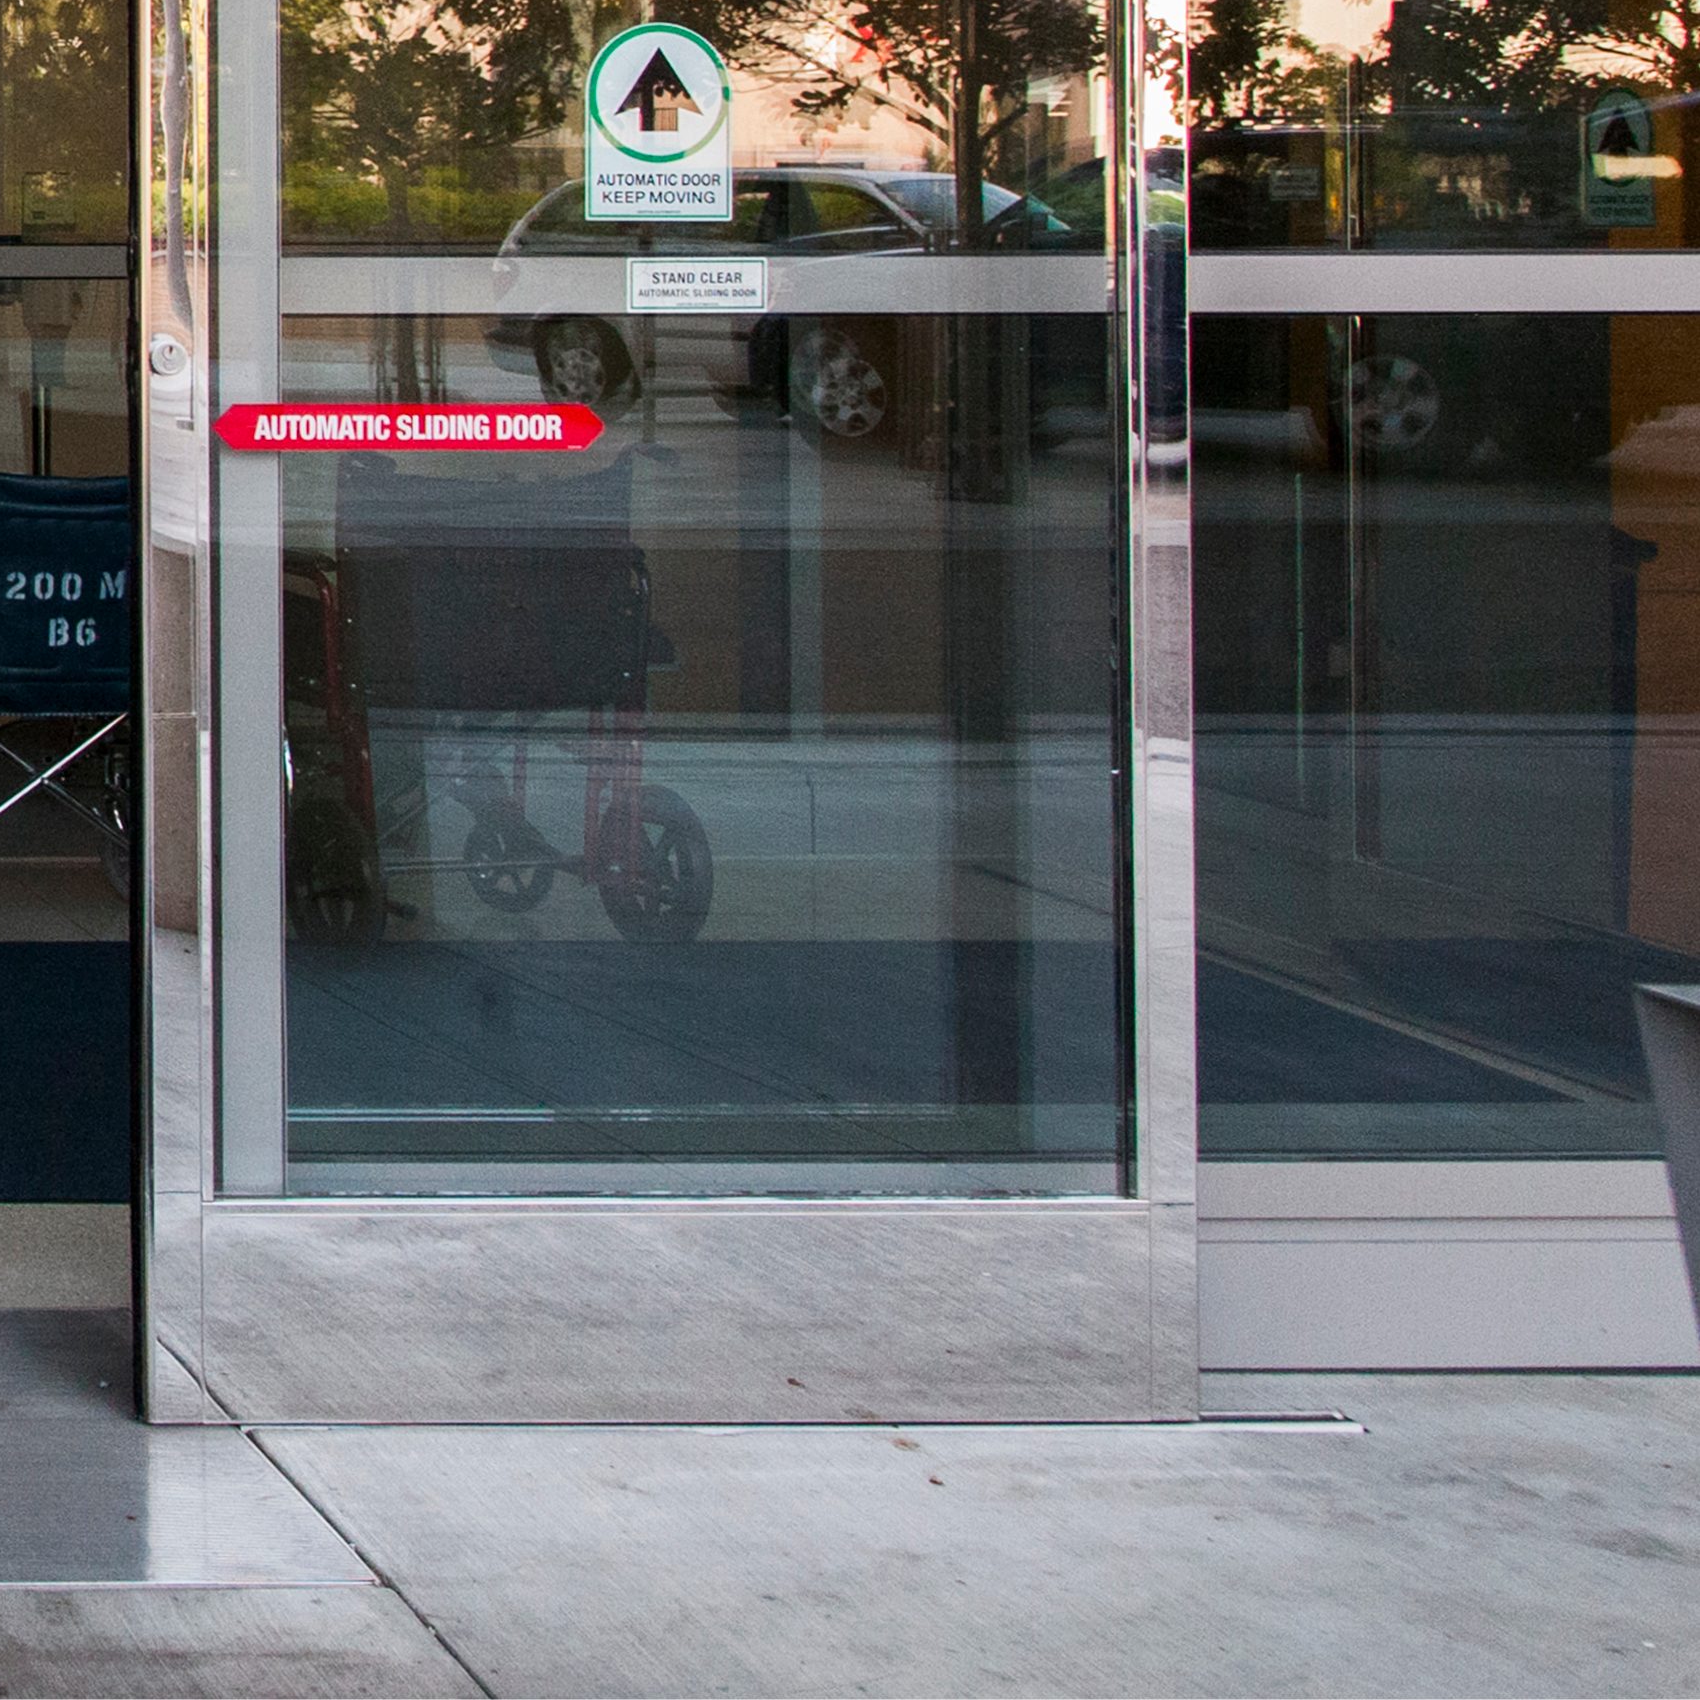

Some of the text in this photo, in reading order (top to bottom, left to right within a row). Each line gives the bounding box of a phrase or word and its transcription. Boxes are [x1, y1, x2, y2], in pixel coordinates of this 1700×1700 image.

[596, 173, 721, 187] AUTOMATIC DOOR
[602, 191, 715, 204] KEEP MOVING
[652, 272, 742, 284] STAND CLEAR
[638, 289, 757, 298] AUTOMATIC SLIDING DOOR
[254, 414, 562, 441] AUTOMATIC SLIDING DOOR
[5, 571, 82, 600] 200
